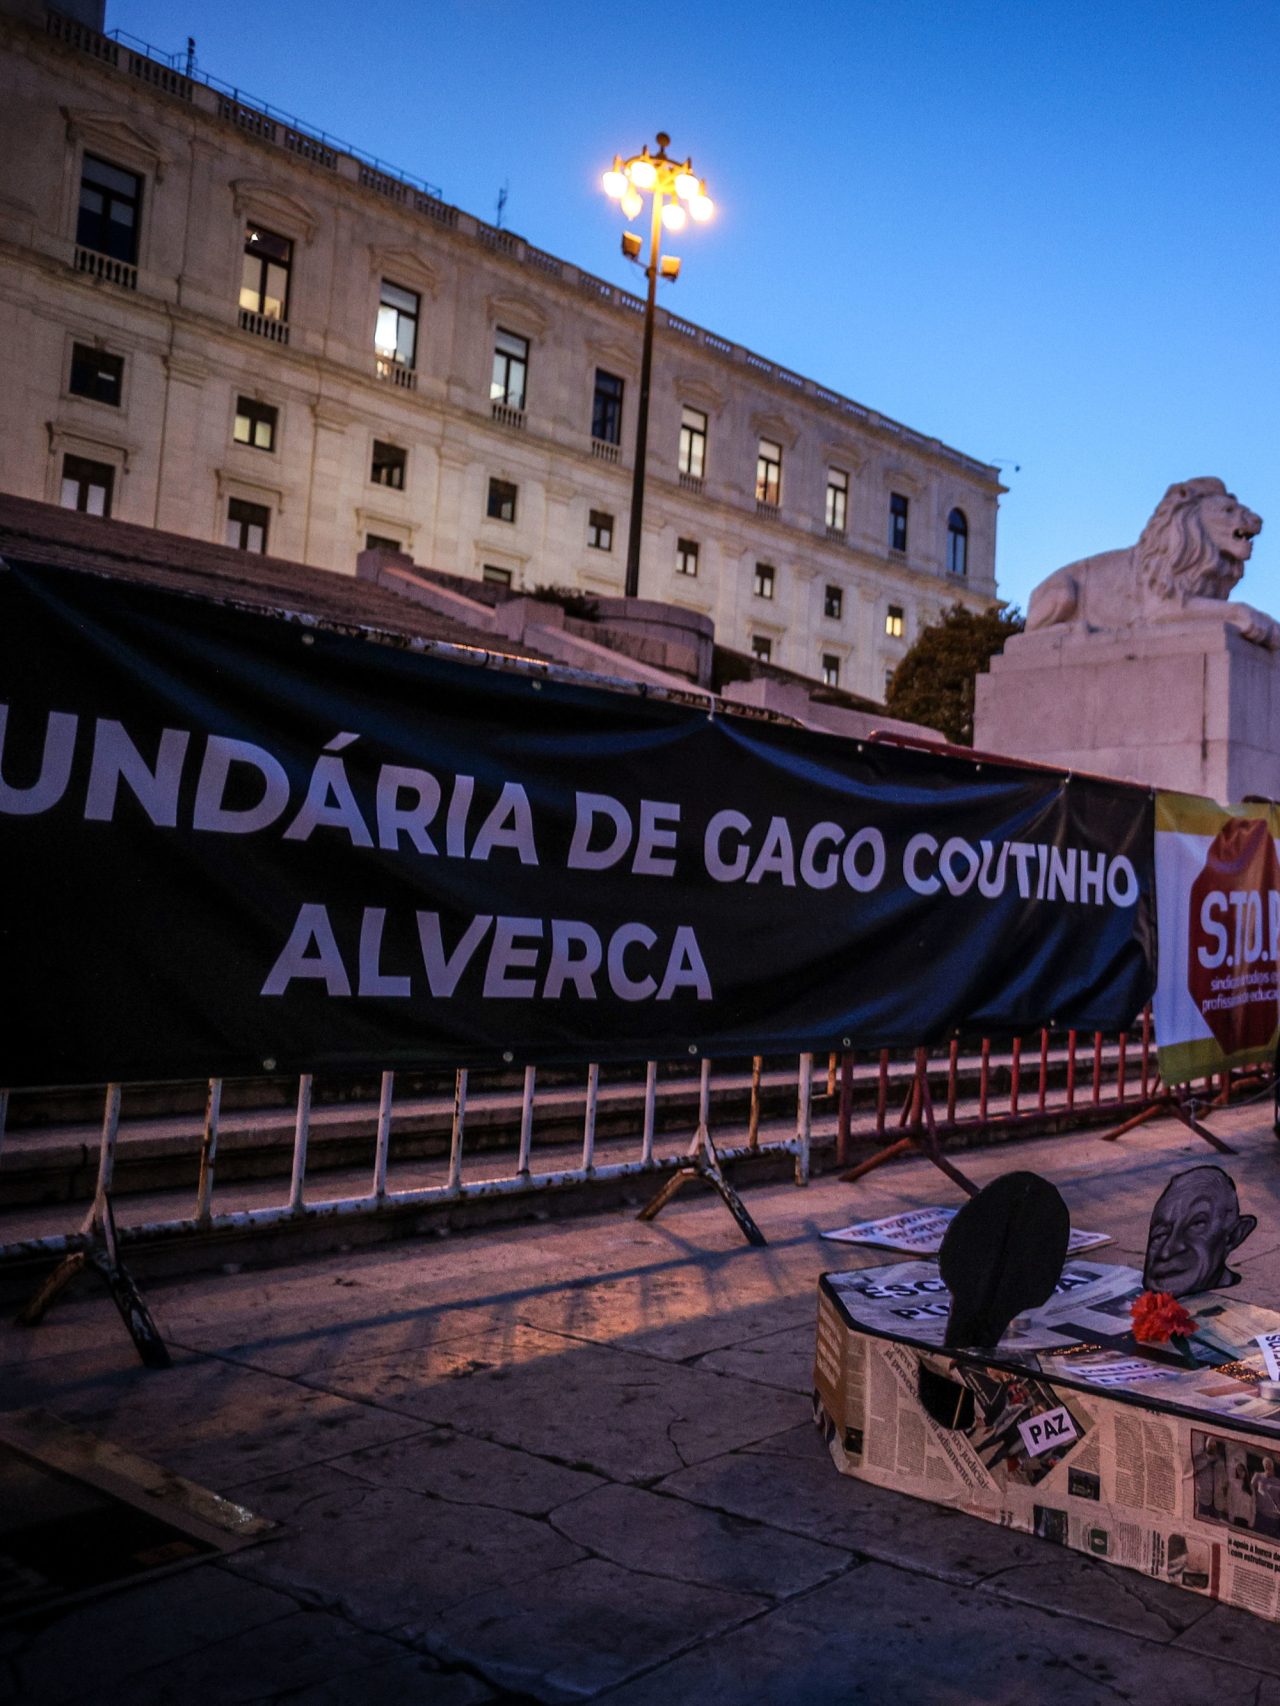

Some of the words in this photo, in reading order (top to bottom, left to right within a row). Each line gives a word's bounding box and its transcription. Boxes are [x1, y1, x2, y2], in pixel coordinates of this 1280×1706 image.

[567, 790, 681, 877] DE
[703, 808, 886, 893] GAGO
[902, 831, 1139, 908] COUTINHO
[260, 903, 713, 1001] ALVERCA
[1028, 1413, 1070, 1445] PAZ
